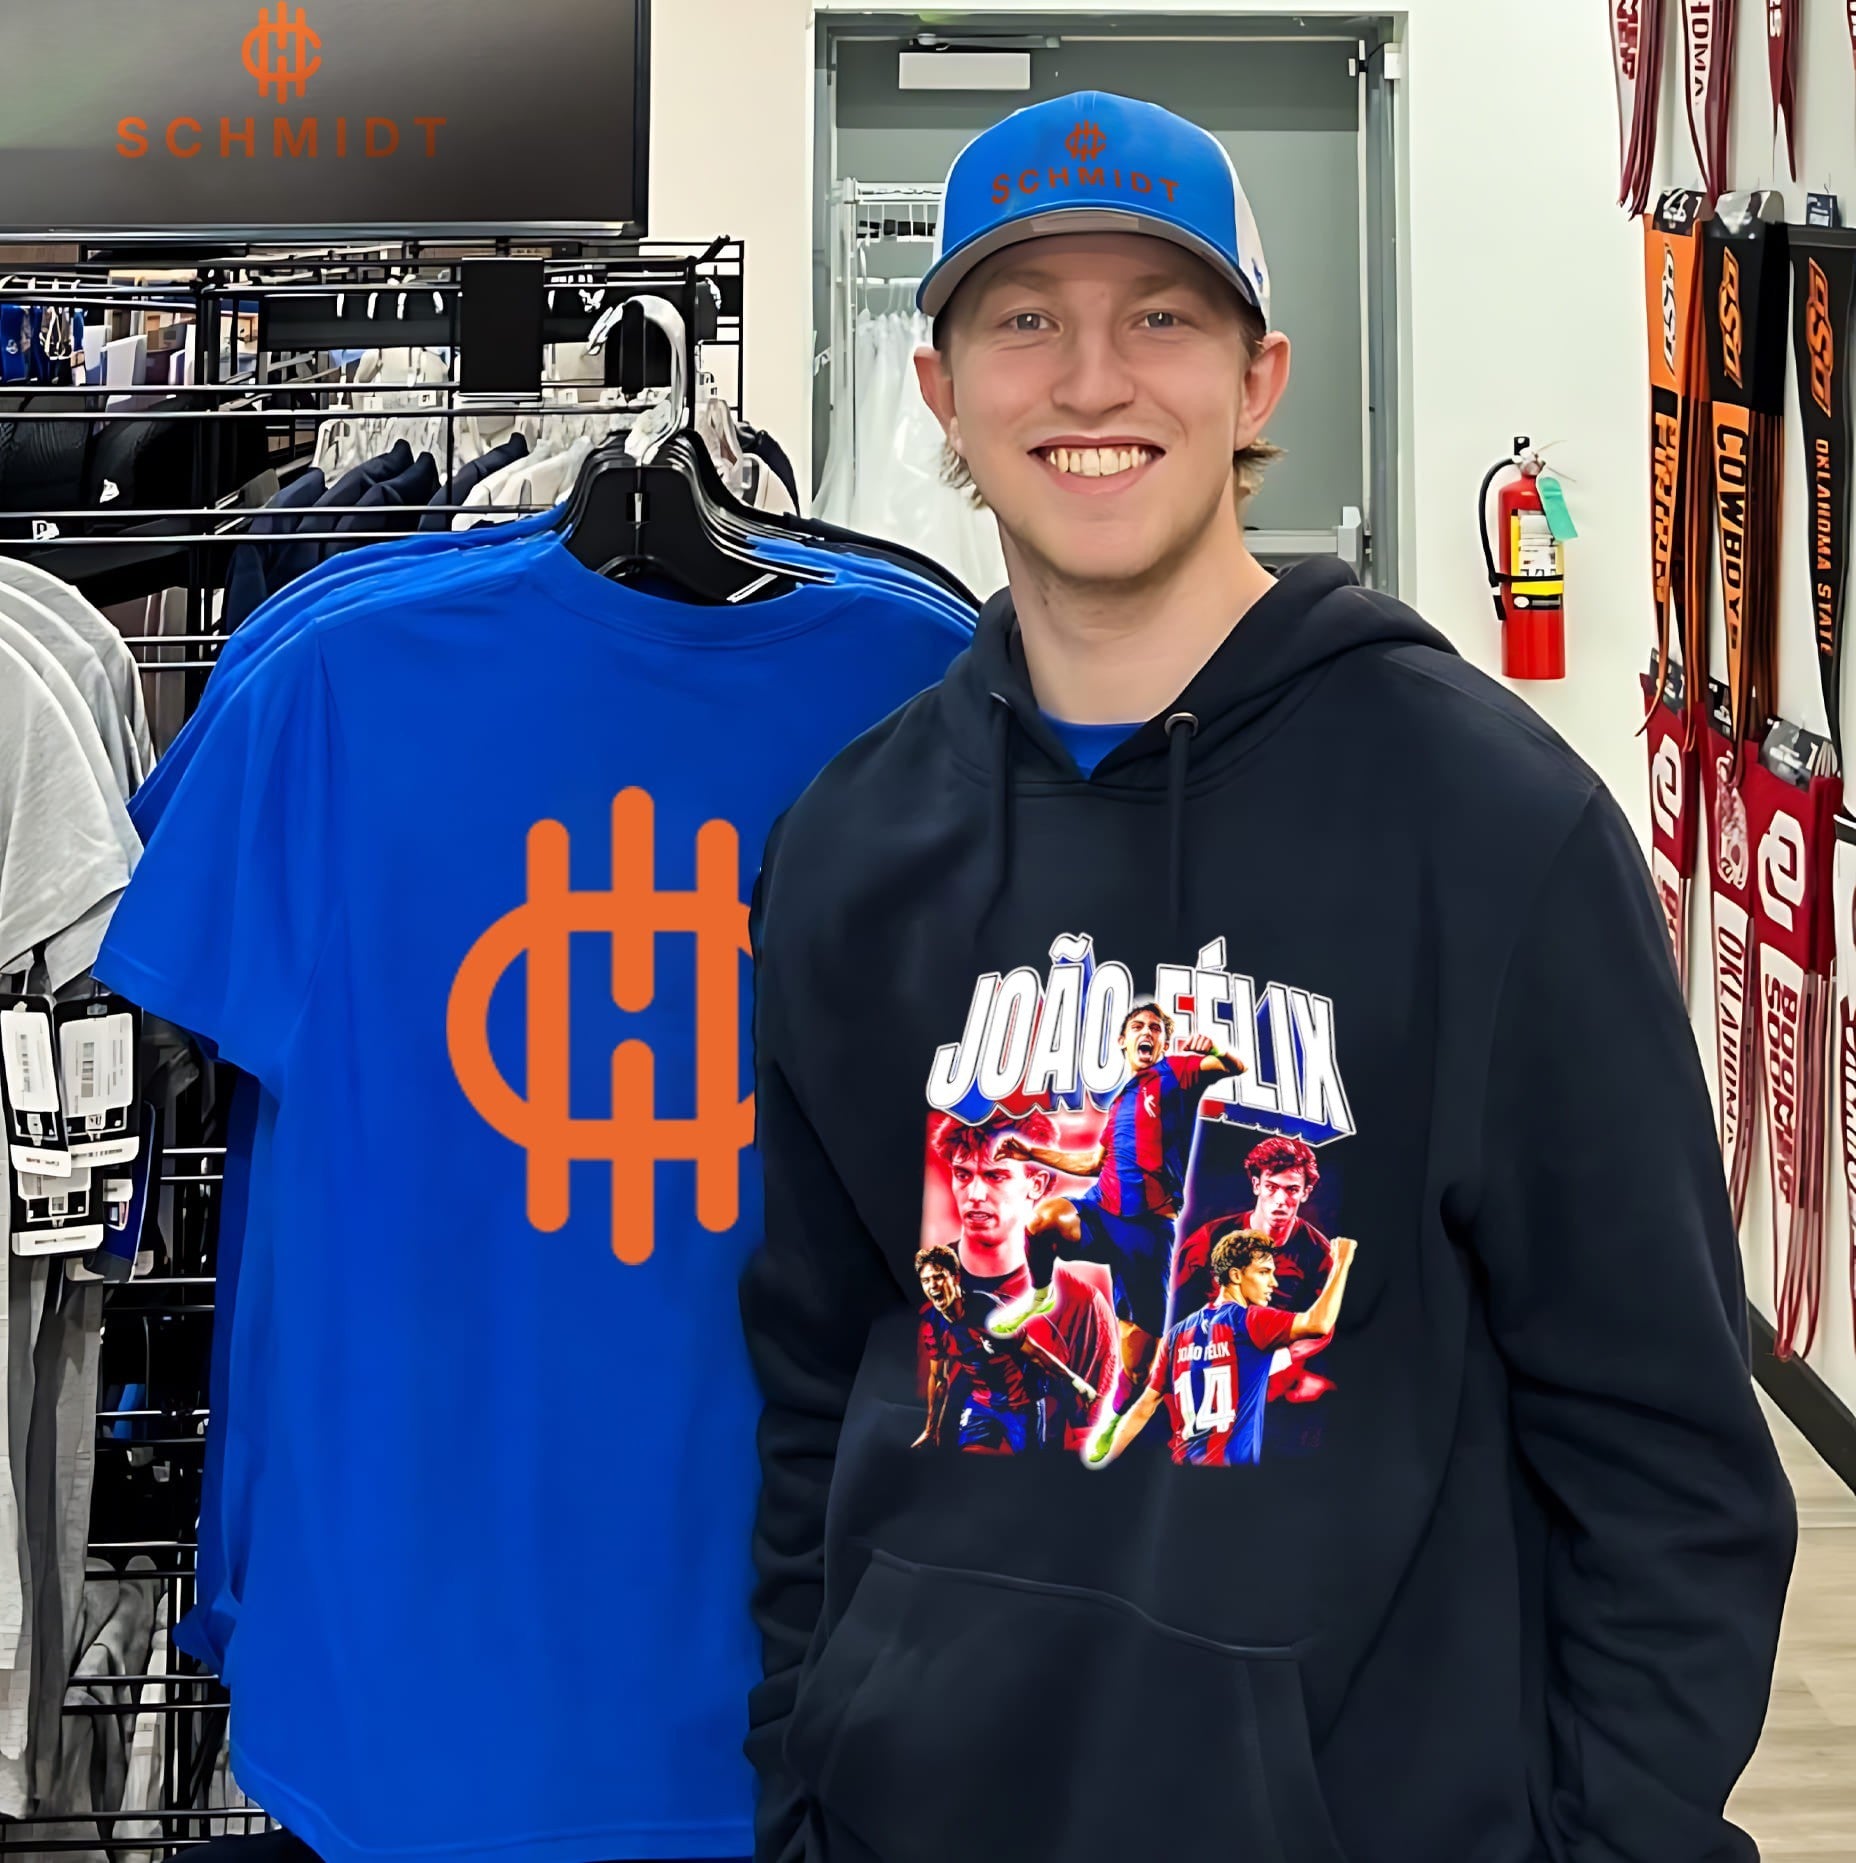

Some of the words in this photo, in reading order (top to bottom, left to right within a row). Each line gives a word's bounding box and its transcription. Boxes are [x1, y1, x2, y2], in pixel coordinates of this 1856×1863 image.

[116, 116, 448, 159] SCHMIDT
[991, 167, 1180, 205] SCHMIDT
[1814, 438, 1832, 571] OKLAHOMA
[926, 932, 1133, 1122] JOÃO
[1717, 925, 1746, 1144] OKLAHOMA
[1177, 1342, 1203, 1363] JOÃO
[1204, 1340, 1231, 1361] FÉLIX
[1173, 1365, 1237, 1440] 14
